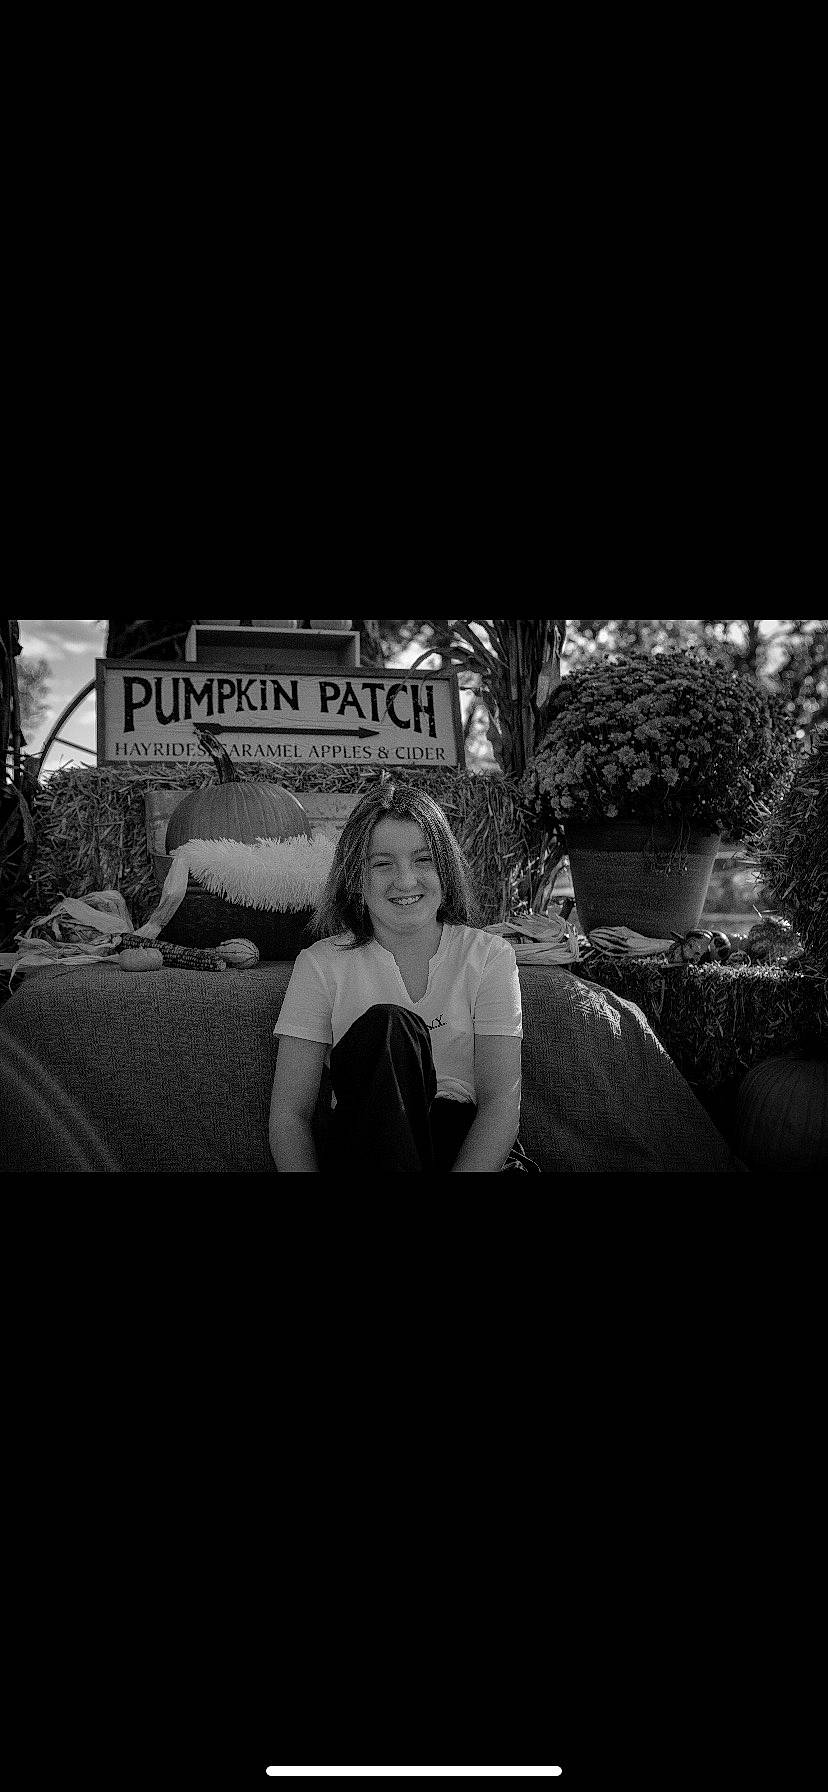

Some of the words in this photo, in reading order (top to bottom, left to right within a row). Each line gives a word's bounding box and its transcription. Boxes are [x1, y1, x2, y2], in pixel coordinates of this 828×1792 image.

[318, 681, 437, 739] PATCH
[219, 743, 303, 758] ARAMEL
[308, 745, 372, 759] APPLES
[377, 747, 389, 759] &
[395, 747, 446, 760] CIDER
